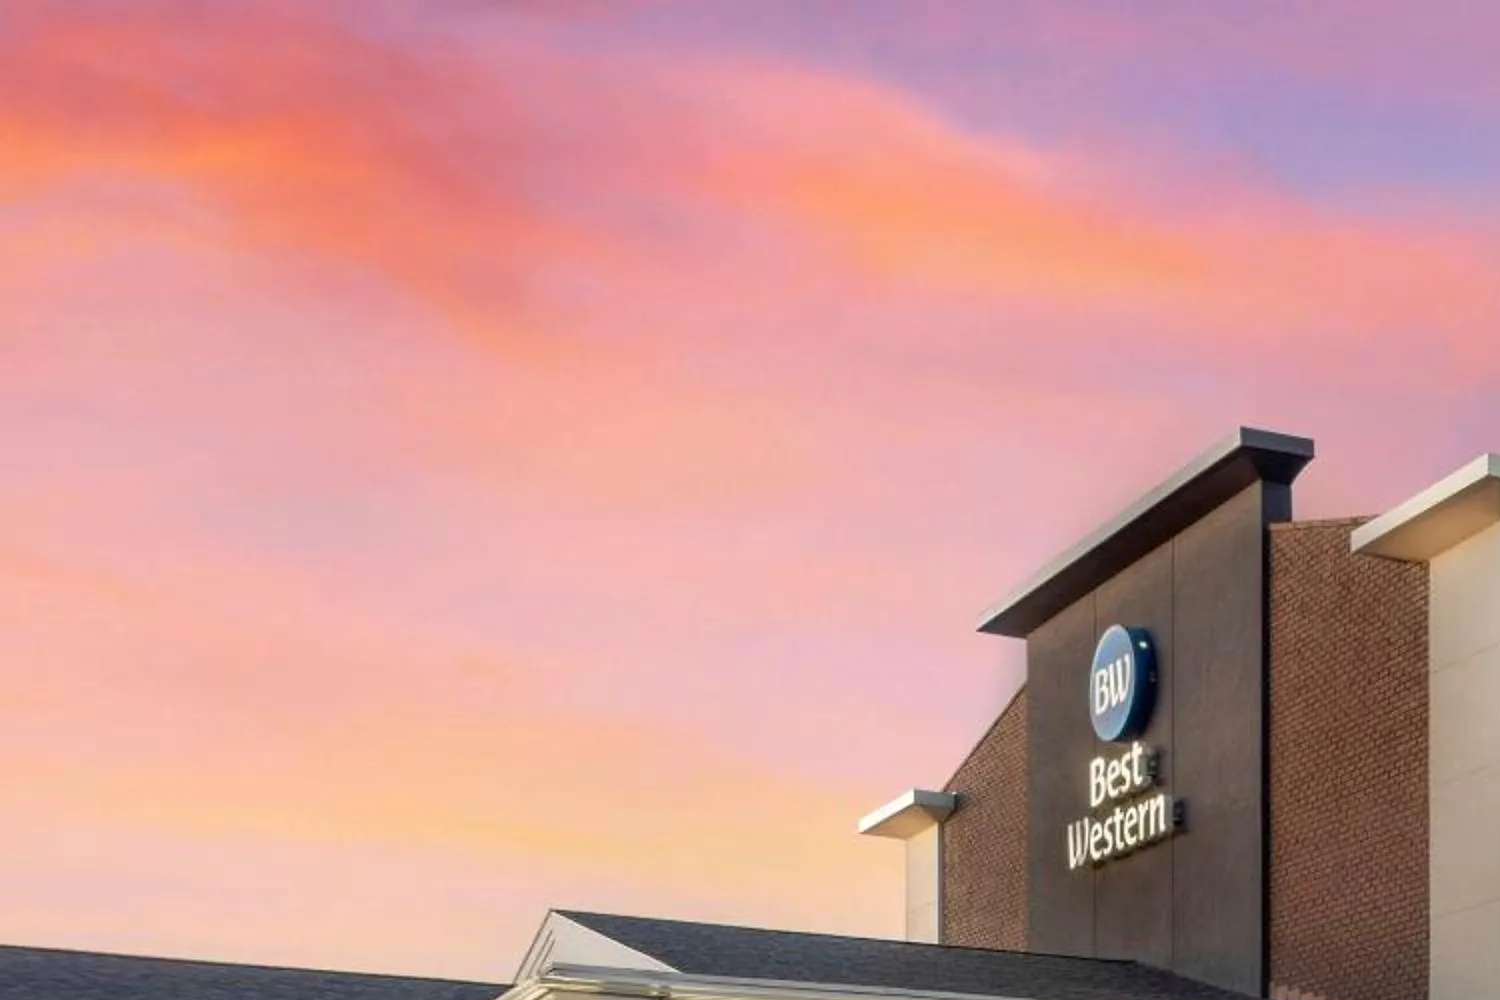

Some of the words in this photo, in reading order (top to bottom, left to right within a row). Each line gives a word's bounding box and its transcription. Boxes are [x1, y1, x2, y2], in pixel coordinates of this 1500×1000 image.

[1095, 653, 1131, 715] BW
[1089, 741, 1143, 808] Best
[1067, 794, 1166, 870] Western
